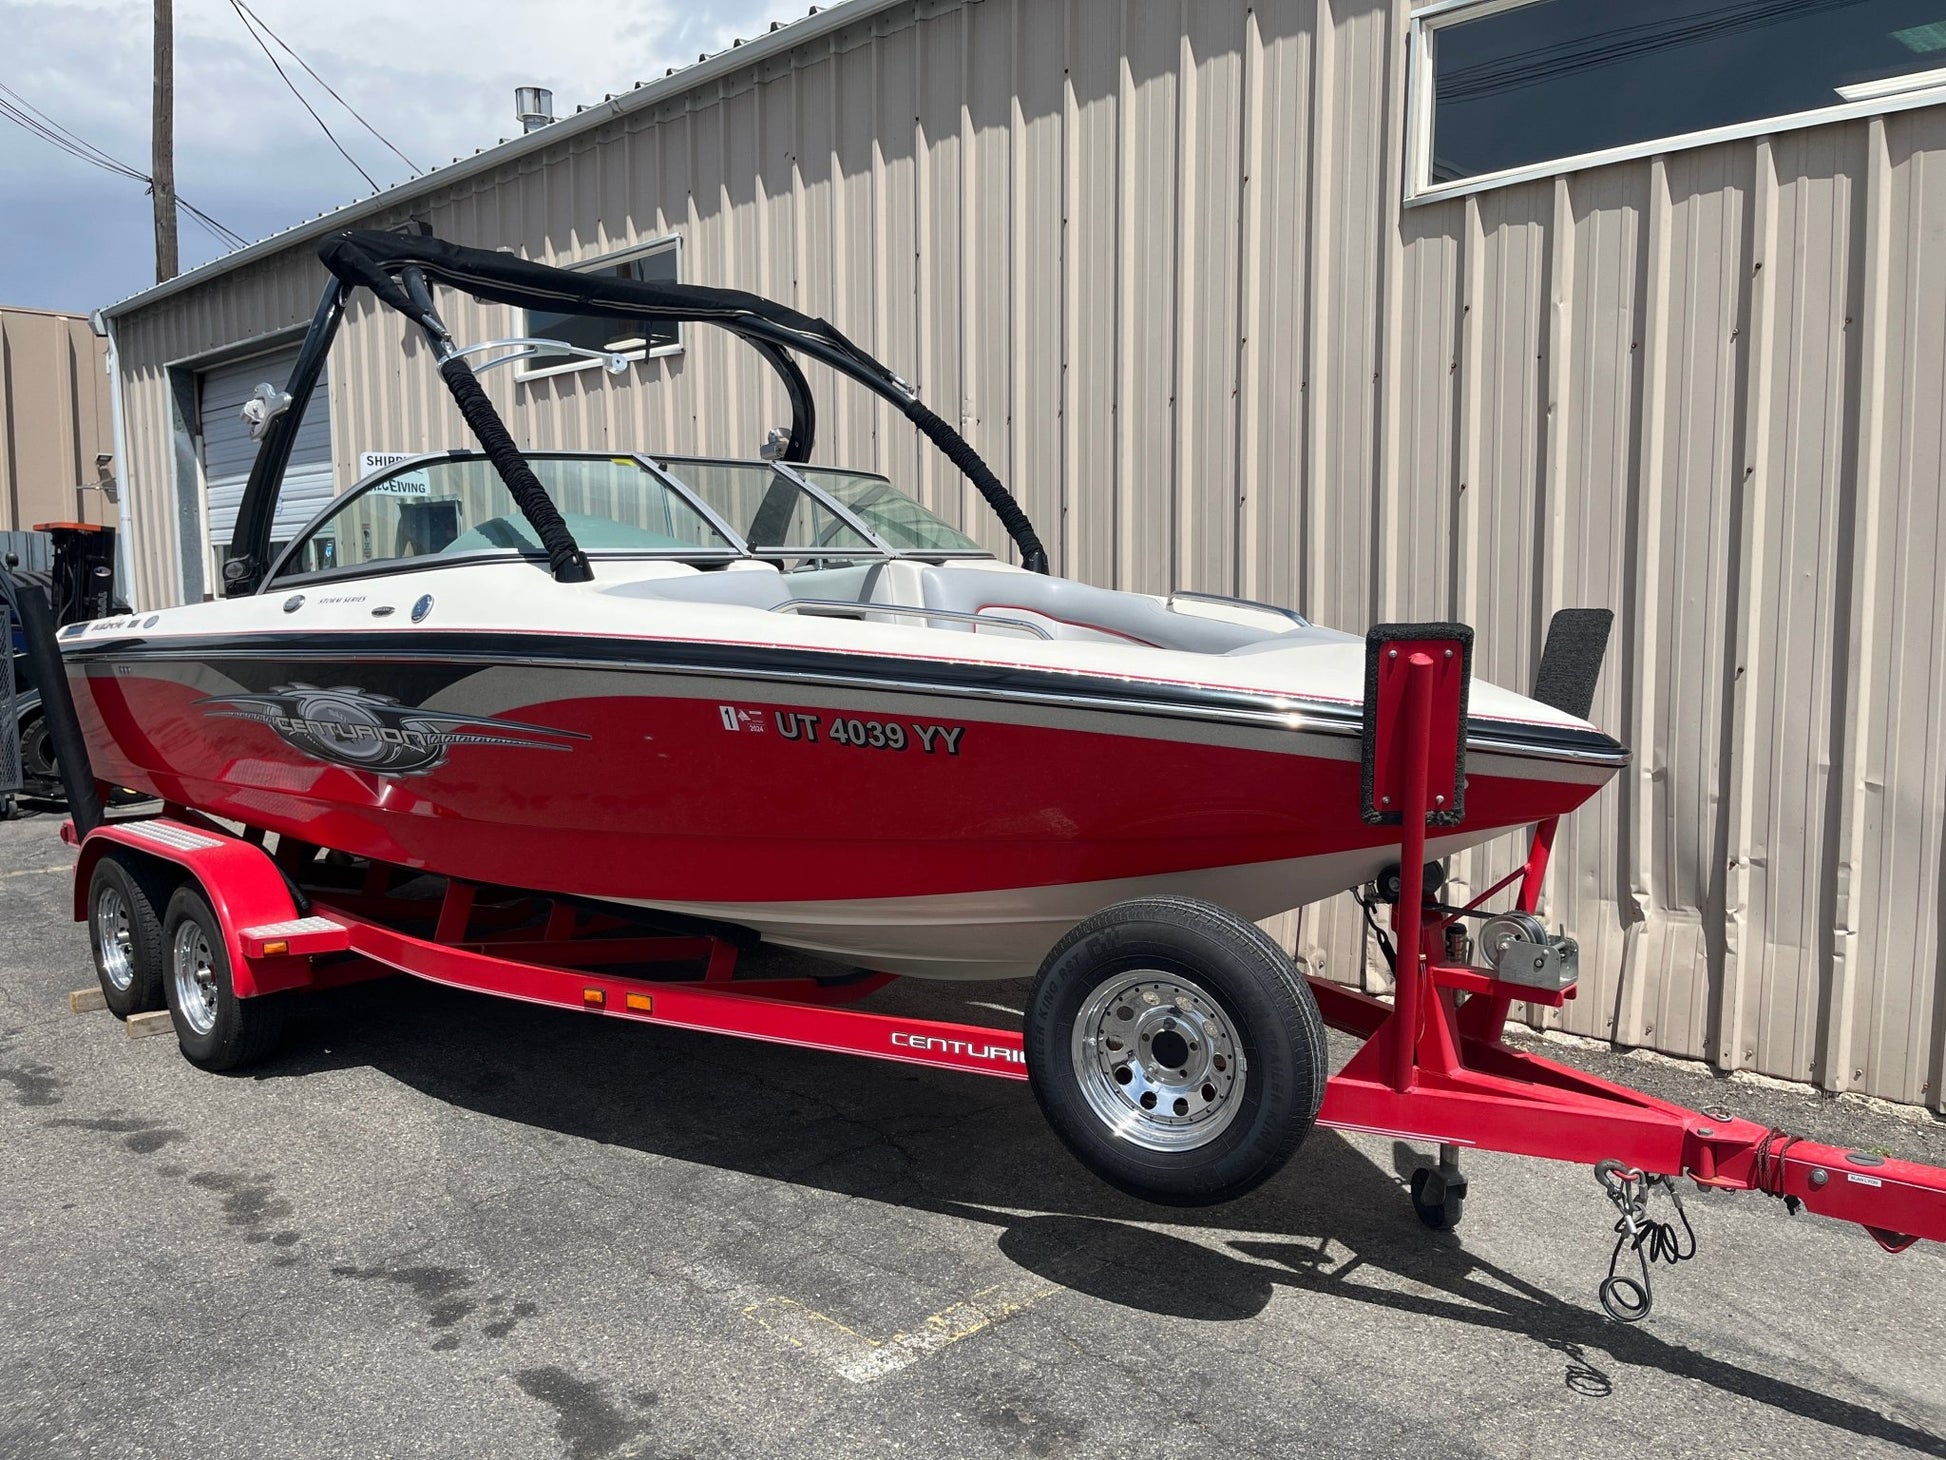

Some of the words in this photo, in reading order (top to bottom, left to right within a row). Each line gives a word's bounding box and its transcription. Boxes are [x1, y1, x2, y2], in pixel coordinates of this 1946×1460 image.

[366, 455, 407, 466] SHIP
[274, 716, 427, 747] CENTURION
[774, 710, 820, 743] UT
[828, 718, 908, 751] 4039
[912, 723, 964, 756] YY
[1038, 980, 1058, 1021] KING
[1058, 952, 1082, 981] RST
